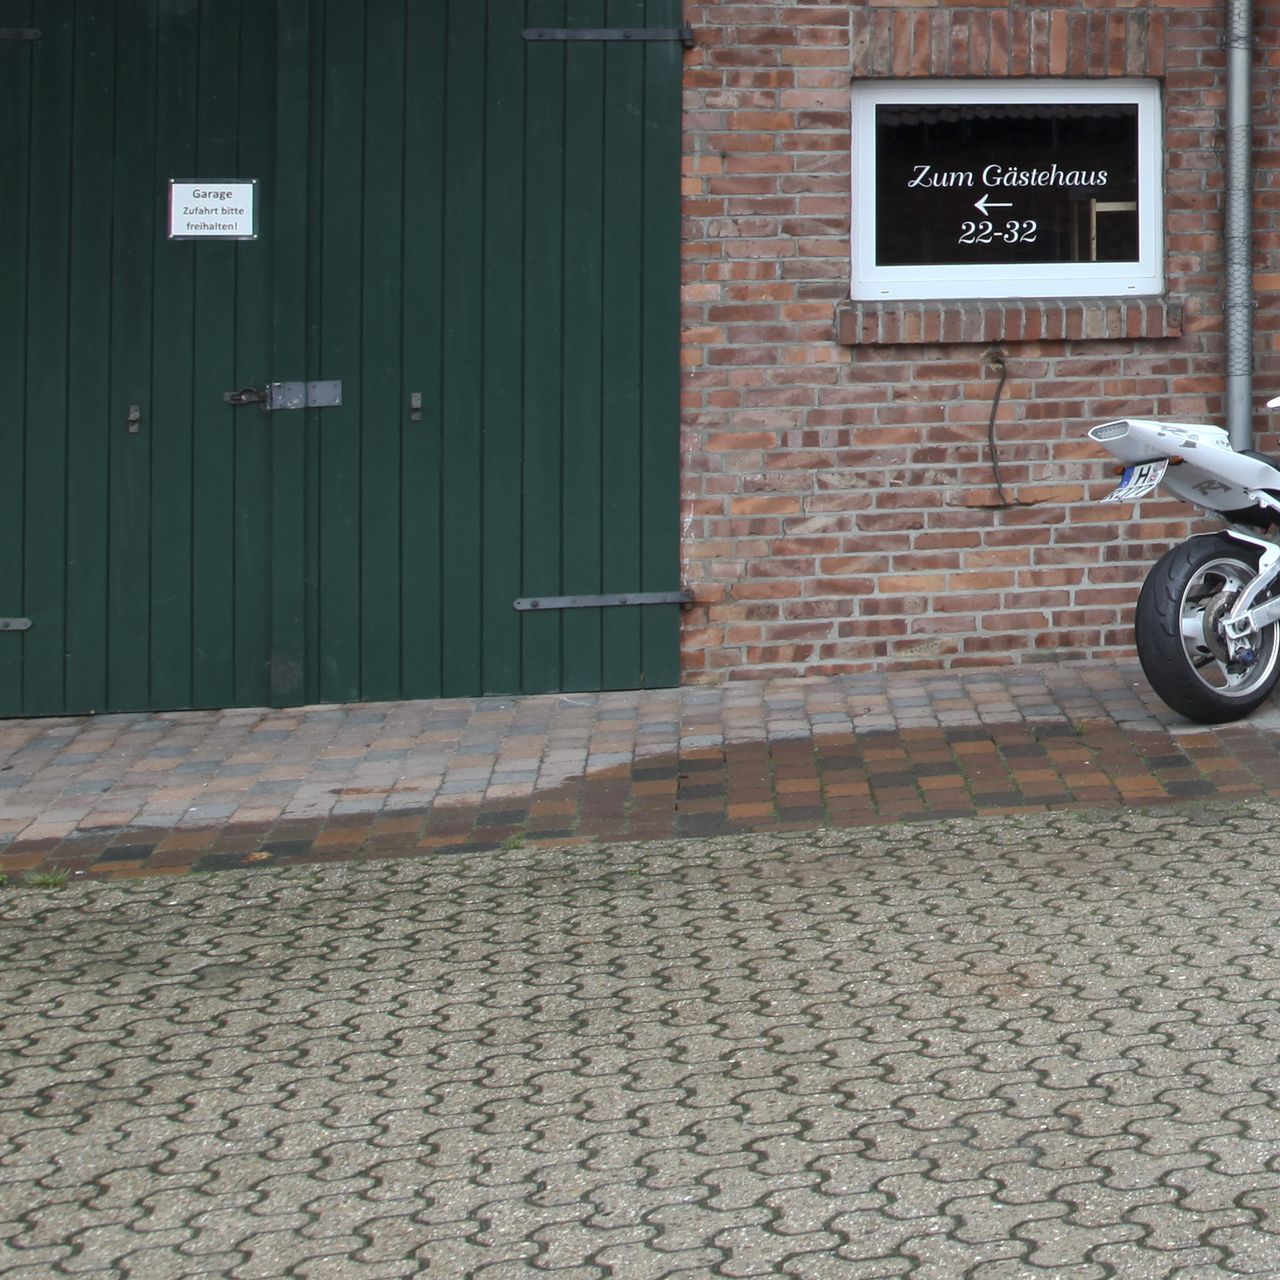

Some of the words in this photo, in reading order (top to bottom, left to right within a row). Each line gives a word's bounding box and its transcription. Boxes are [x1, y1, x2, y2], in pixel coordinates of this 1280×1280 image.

[908, 165, 974, 187] Zum
[982, 164, 1107, 187] Gästehaus
[192, 189, 233, 201] Garage
[183, 207, 218, 215] Zufahrt
[221, 207, 245, 215] bitte
[186, 222, 238, 231] freihalten!
[958, 220, 1037, 243] 22-32
